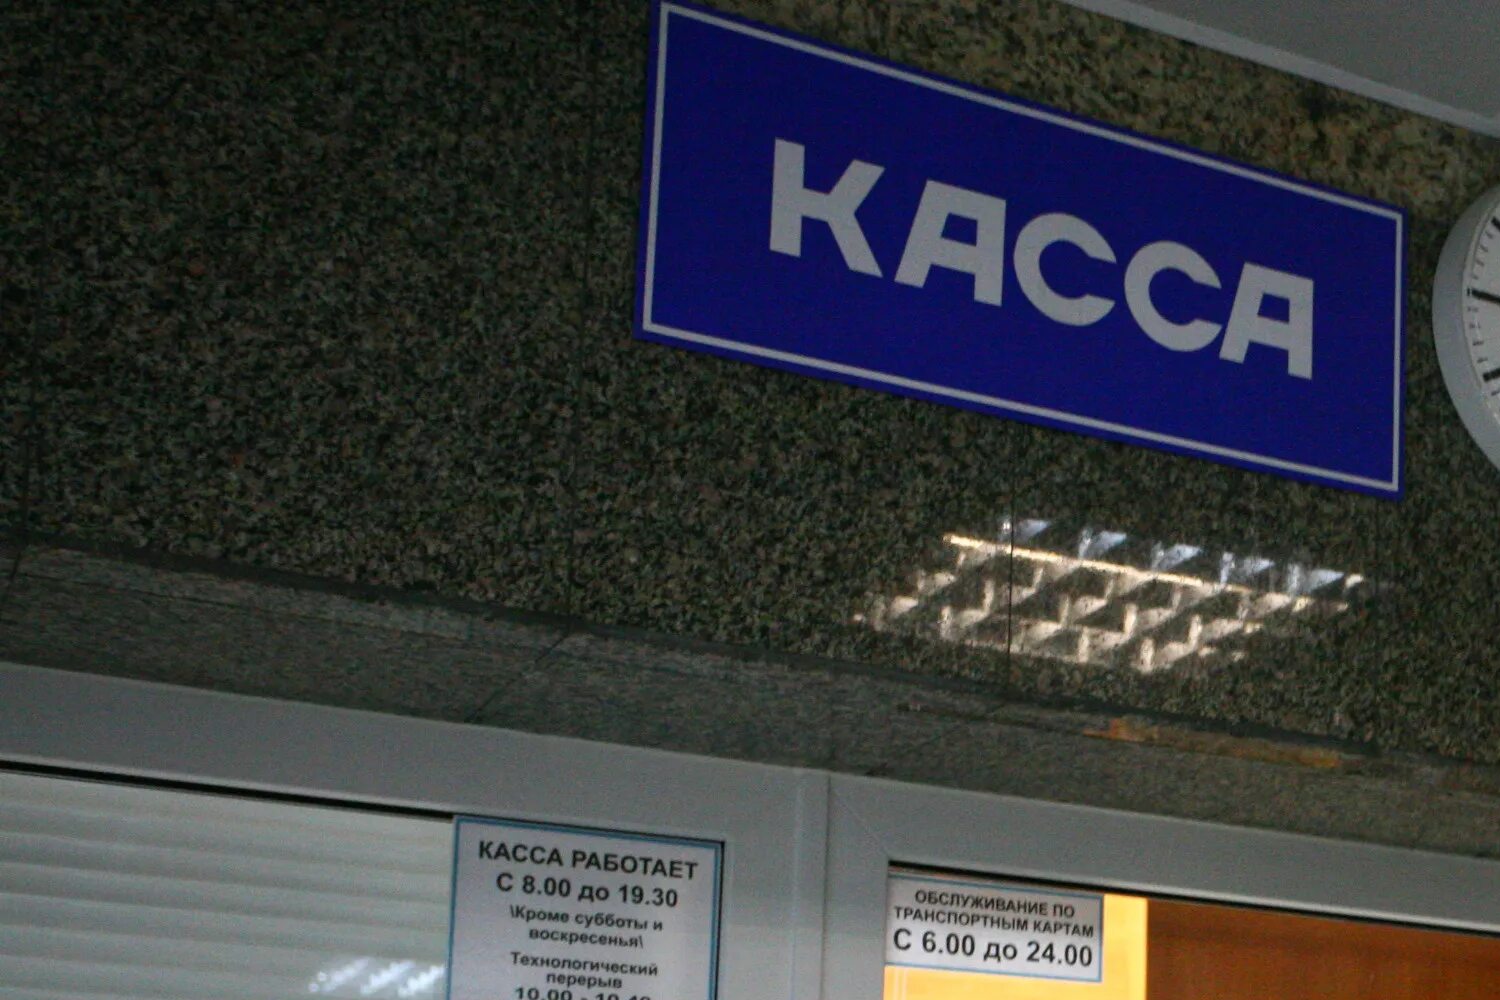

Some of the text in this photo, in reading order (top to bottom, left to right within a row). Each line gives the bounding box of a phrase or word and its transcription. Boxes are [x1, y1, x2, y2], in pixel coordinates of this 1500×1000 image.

[769, 138, 1314, 380] КАССА
[478, 840, 699, 880] КАССА РАБОТАЕТ
[496, 872, 678, 908] С 8.00 до 19.30
[914, 889, 1075, 919] ОБСЛУЖИВАНИЕ ПО
[574, 910, 648, 931] субботы
[652, 919, 663, 931] и
[894, 906, 1094, 938] ТРАНСПОРТНЫМ КАРТАМ
[510, 951, 659, 976] Технологический
[893, 928, 1093, 967] С 6.00 до 24.00
[546, 973, 623, 988] перерыв
